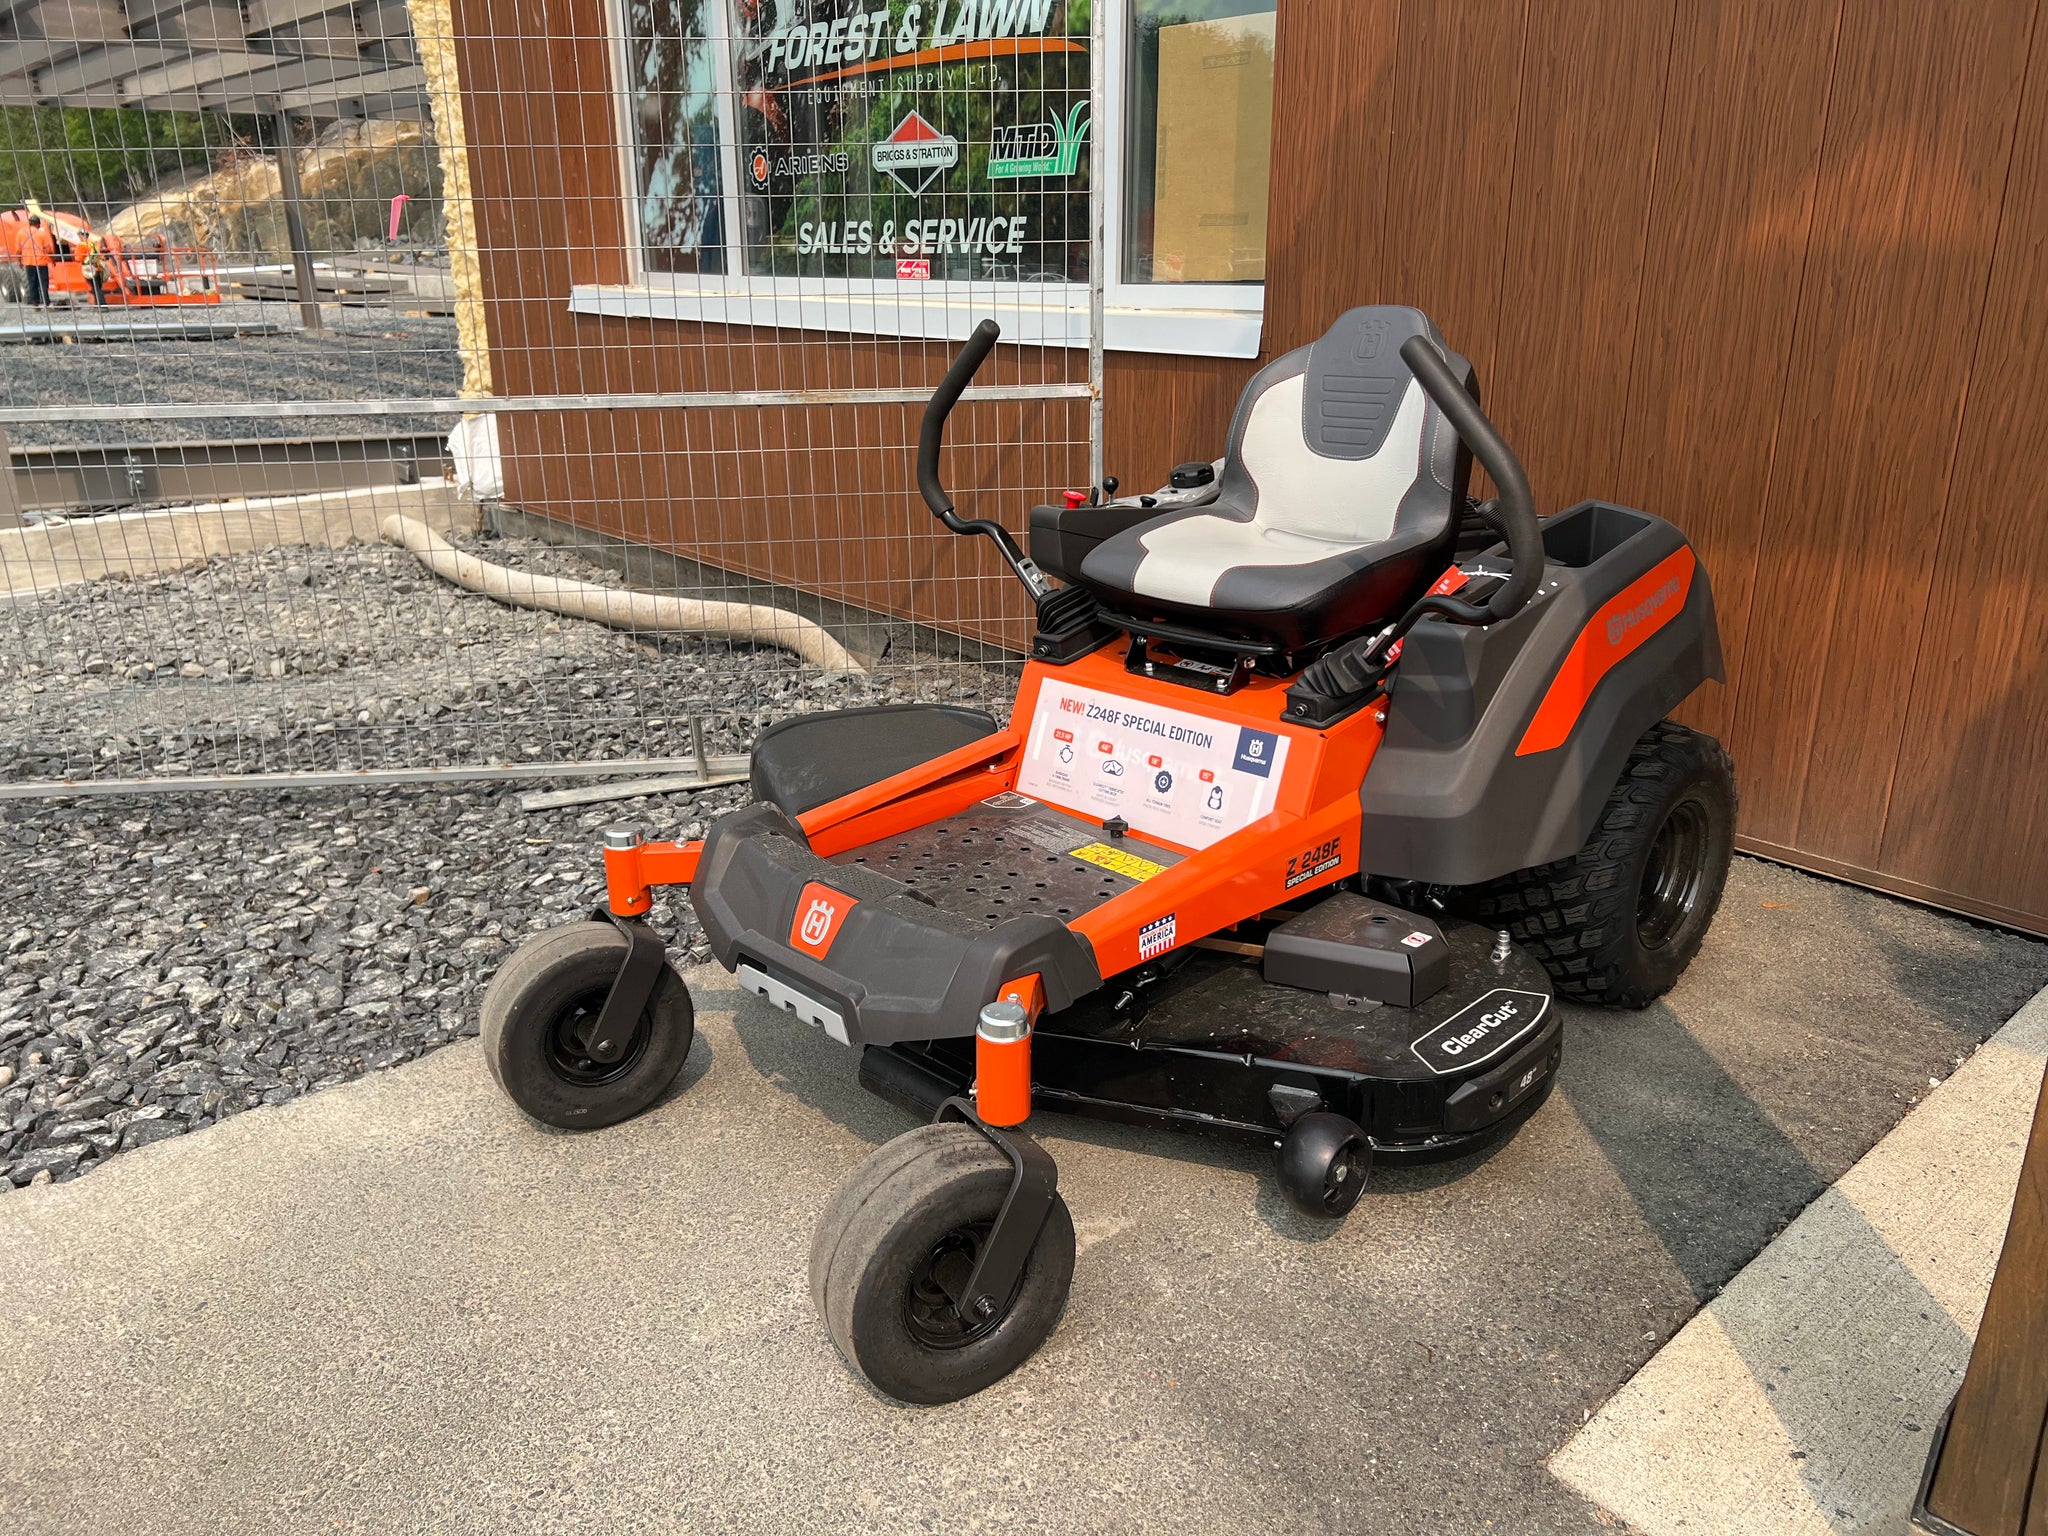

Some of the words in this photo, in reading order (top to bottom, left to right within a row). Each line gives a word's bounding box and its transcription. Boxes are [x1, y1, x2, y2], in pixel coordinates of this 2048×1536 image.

[768, 10, 890, 73] FOREST
[895, 4, 921, 54] &
[930, 0, 1054, 49] LAWN
[808, 78, 885, 105] EQUIPMENT
[897, 69, 954, 92] SUPPLY
[969, 64, 1002, 85] LTD.
[877, 149, 905, 162] BRIGGS
[905, 148, 912, 160] &
[990, 122, 1058, 160] MTD
[775, 152, 849, 176] ARIENS
[995, 163, 1004, 175] For
[1004, 163, 1009, 174] A
[798, 220, 873, 255] SALES
[878, 219, 896, 255] &
[902, 216, 1028, 254] SERVICE
[1060, 697, 1086, 716] NEW!
[1086, 704, 1121, 725] Z248F
[1121, 713, 1167, 738] SPECIAL
[1168, 725, 1213, 749] EDITION
[1286, 857, 1298, 877] Z
[1301, 837, 1340, 869] 248F
[1286, 869, 1314, 888] SPECIAL
[1314, 855, 1340, 875] EDITION
[1141, 927, 1174, 948] AMERICA
